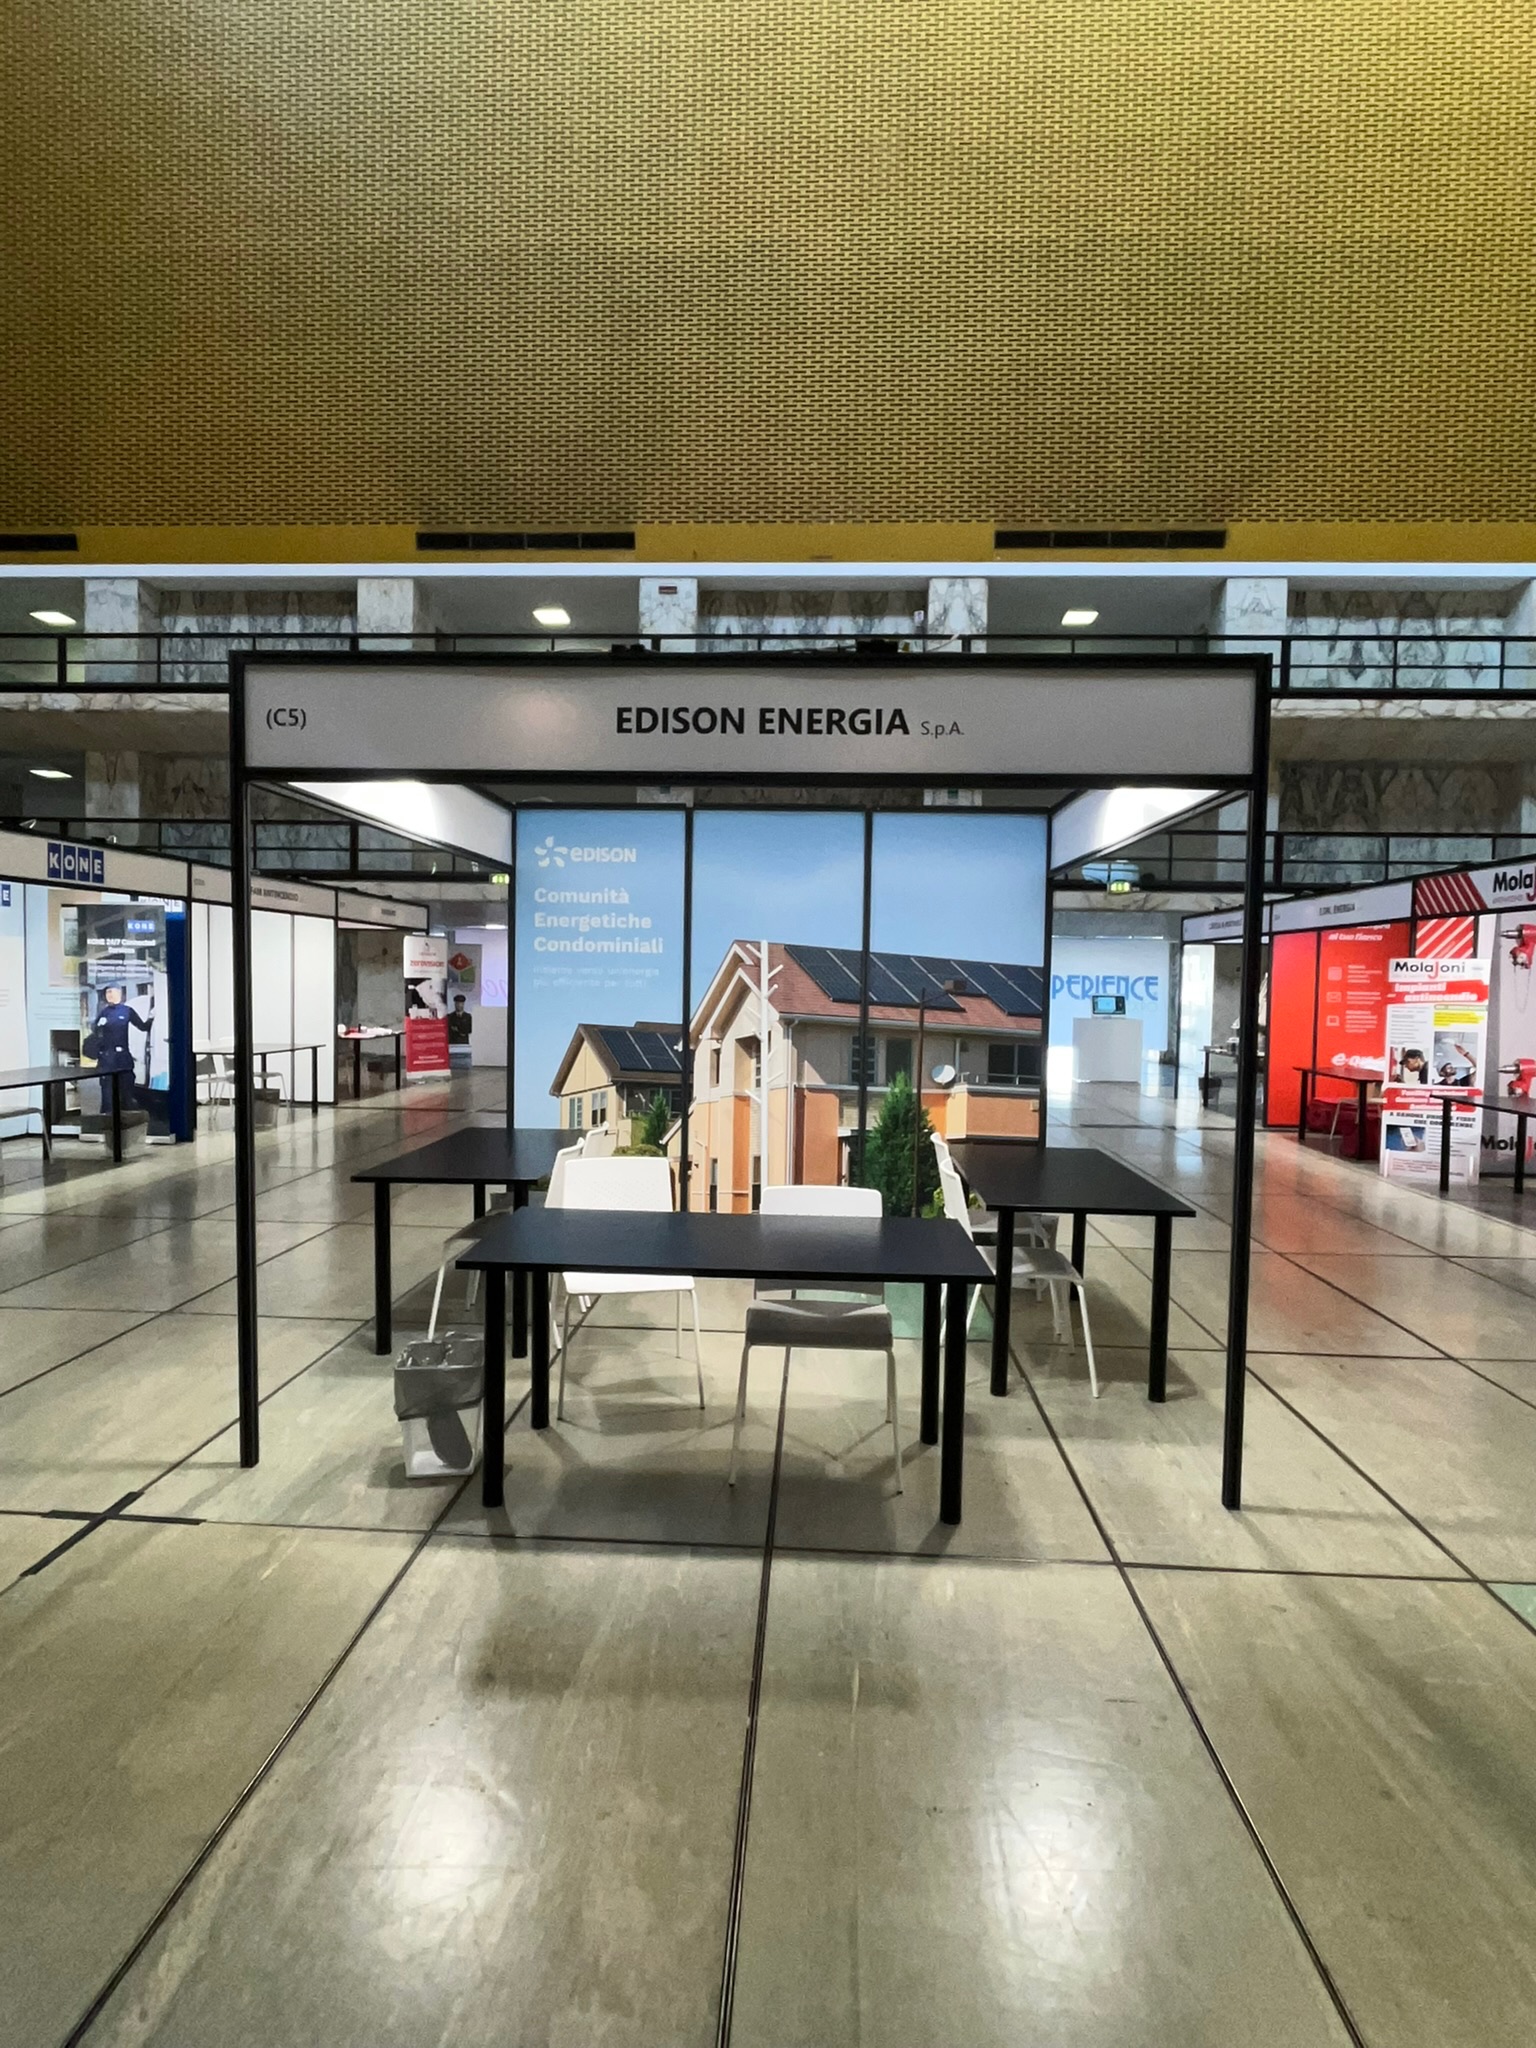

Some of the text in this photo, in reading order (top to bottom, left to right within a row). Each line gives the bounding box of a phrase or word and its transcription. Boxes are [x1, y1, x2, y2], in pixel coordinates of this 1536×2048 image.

[266, 708, 306, 730] (C5)
[616, 706, 965, 739] EDISON ENERGIA S.p.A.
[49, 850, 104, 876] KONE
[534, 887, 630, 904] Comunità
[534, 912, 652, 932] Energetiche
[534, 936, 664, 953] Condominiali
